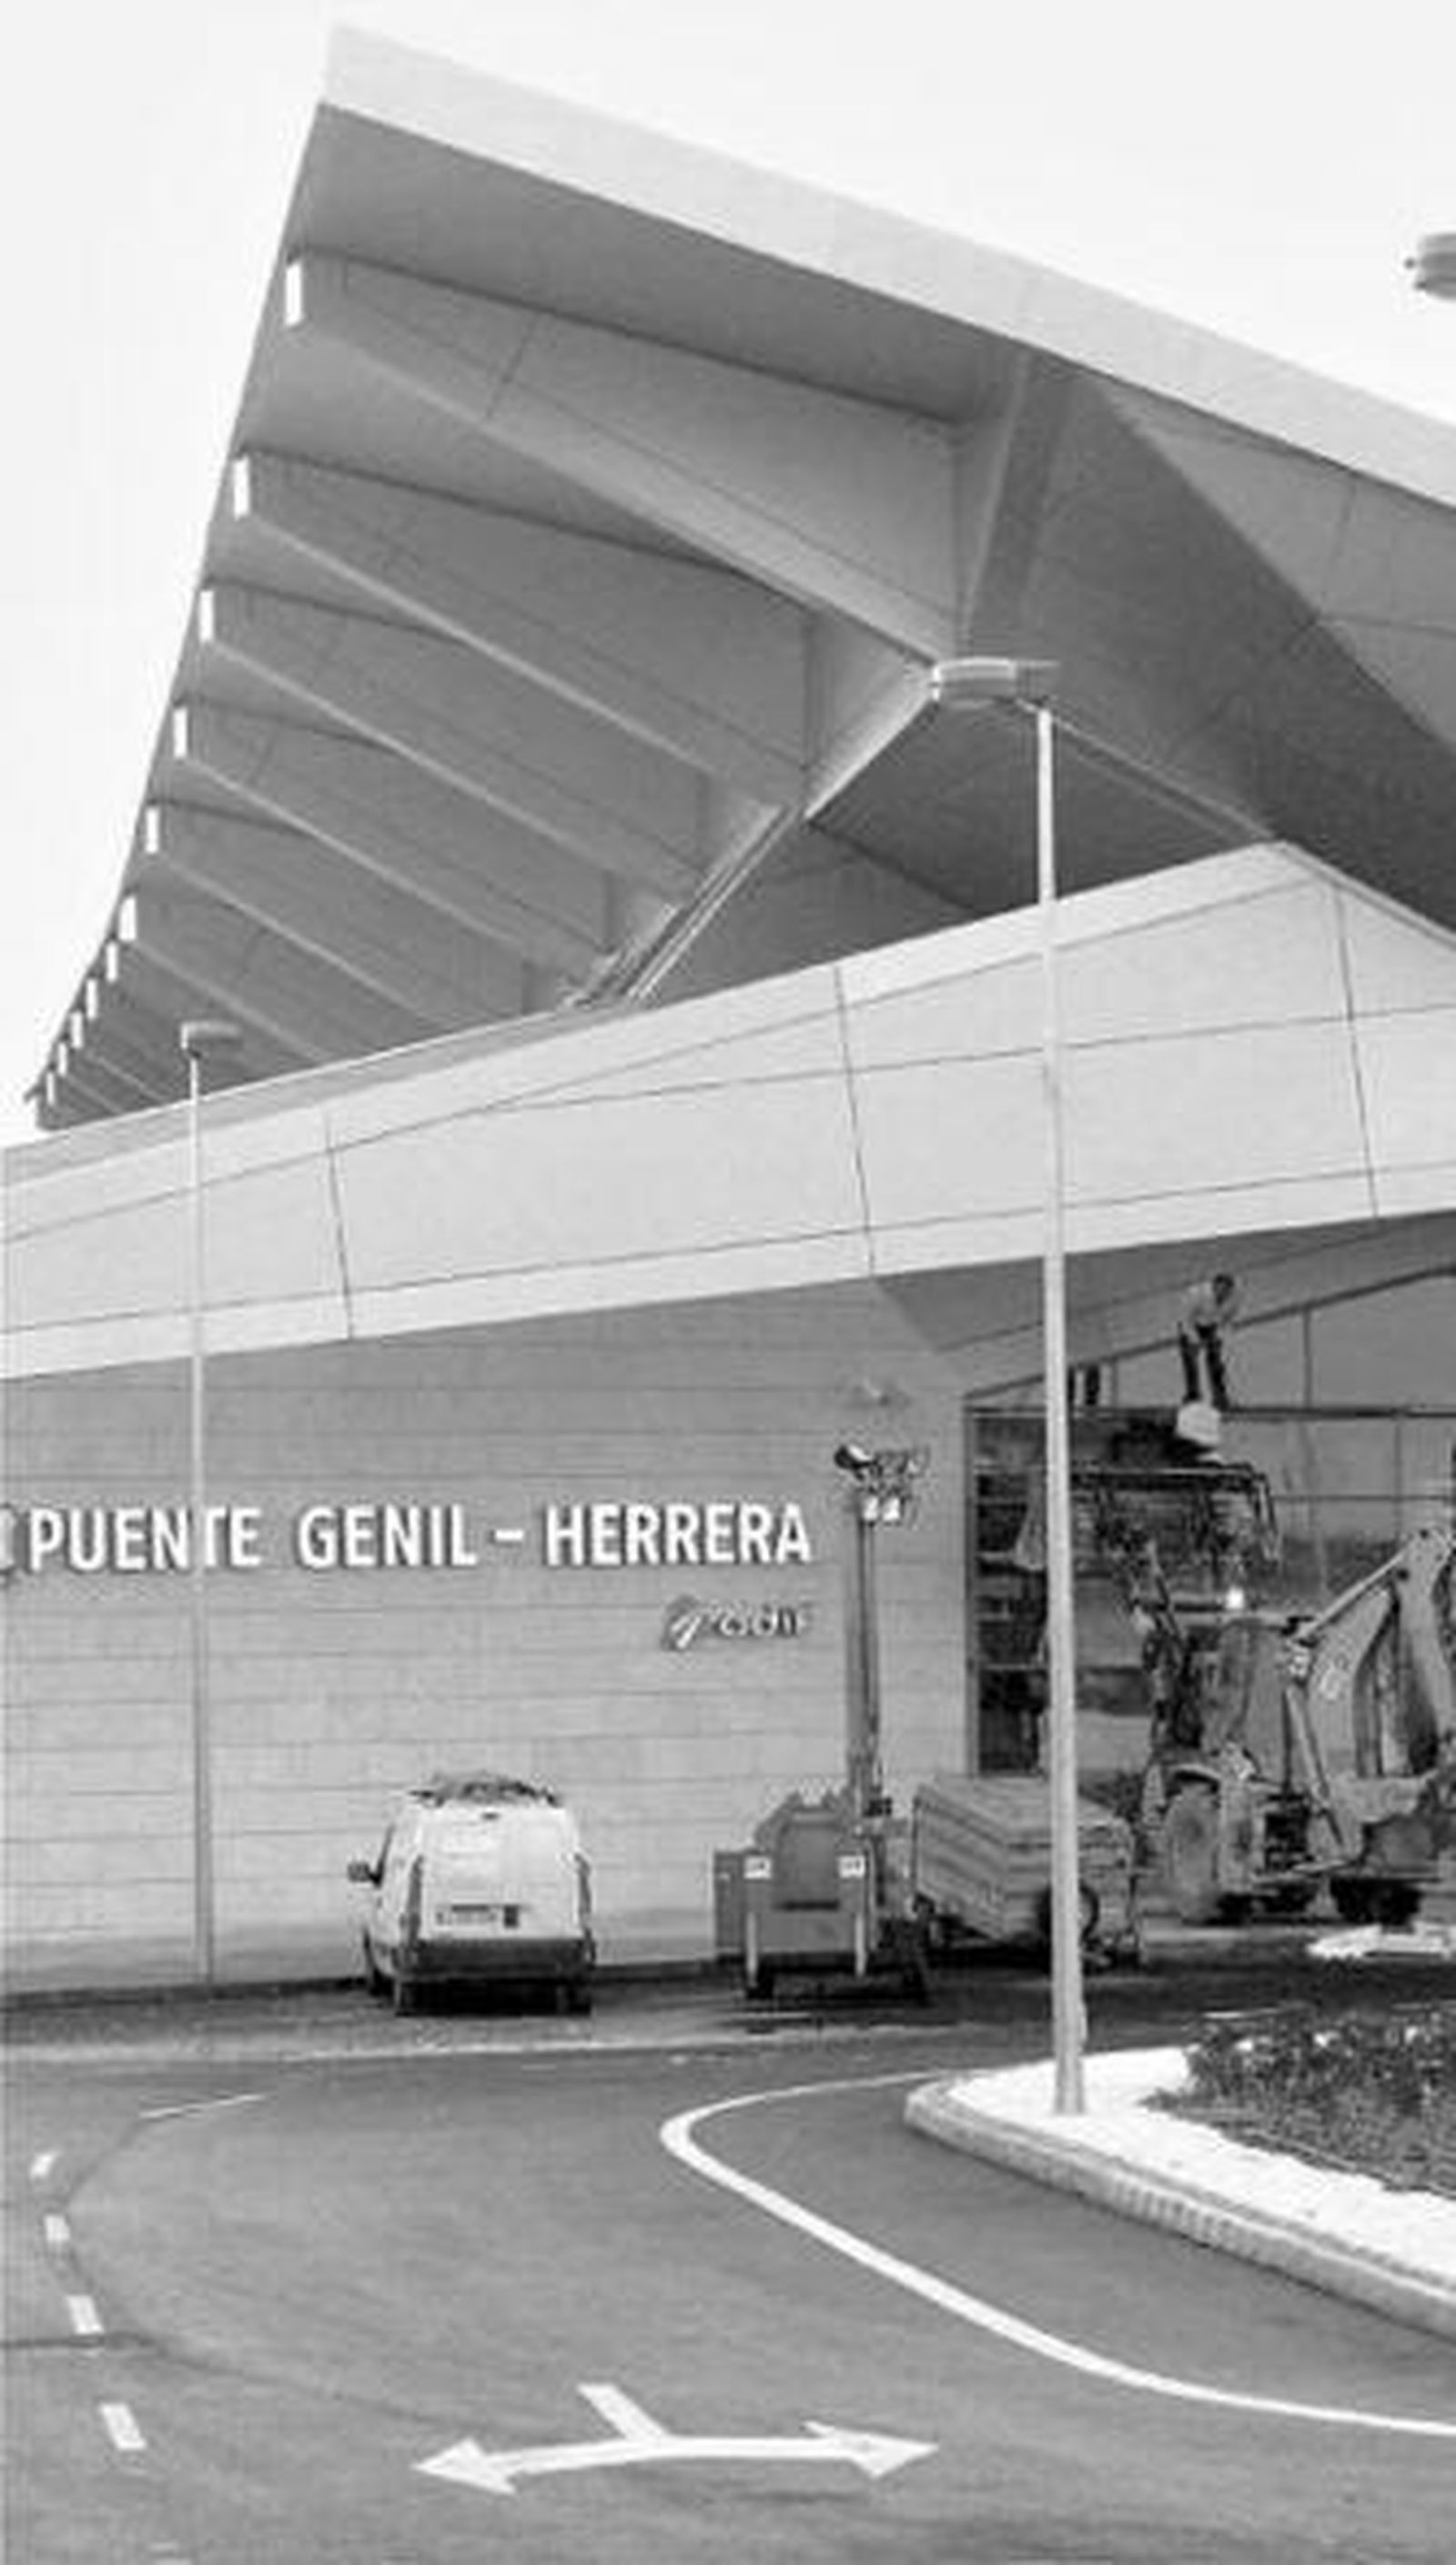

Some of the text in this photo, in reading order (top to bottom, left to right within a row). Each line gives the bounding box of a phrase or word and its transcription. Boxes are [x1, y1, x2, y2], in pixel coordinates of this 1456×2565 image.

[28, 1506, 263, 1571] PUENTE
[297, 1504, 478, 1566] GENIL
[547, 1502, 813, 1566] HERRERA
